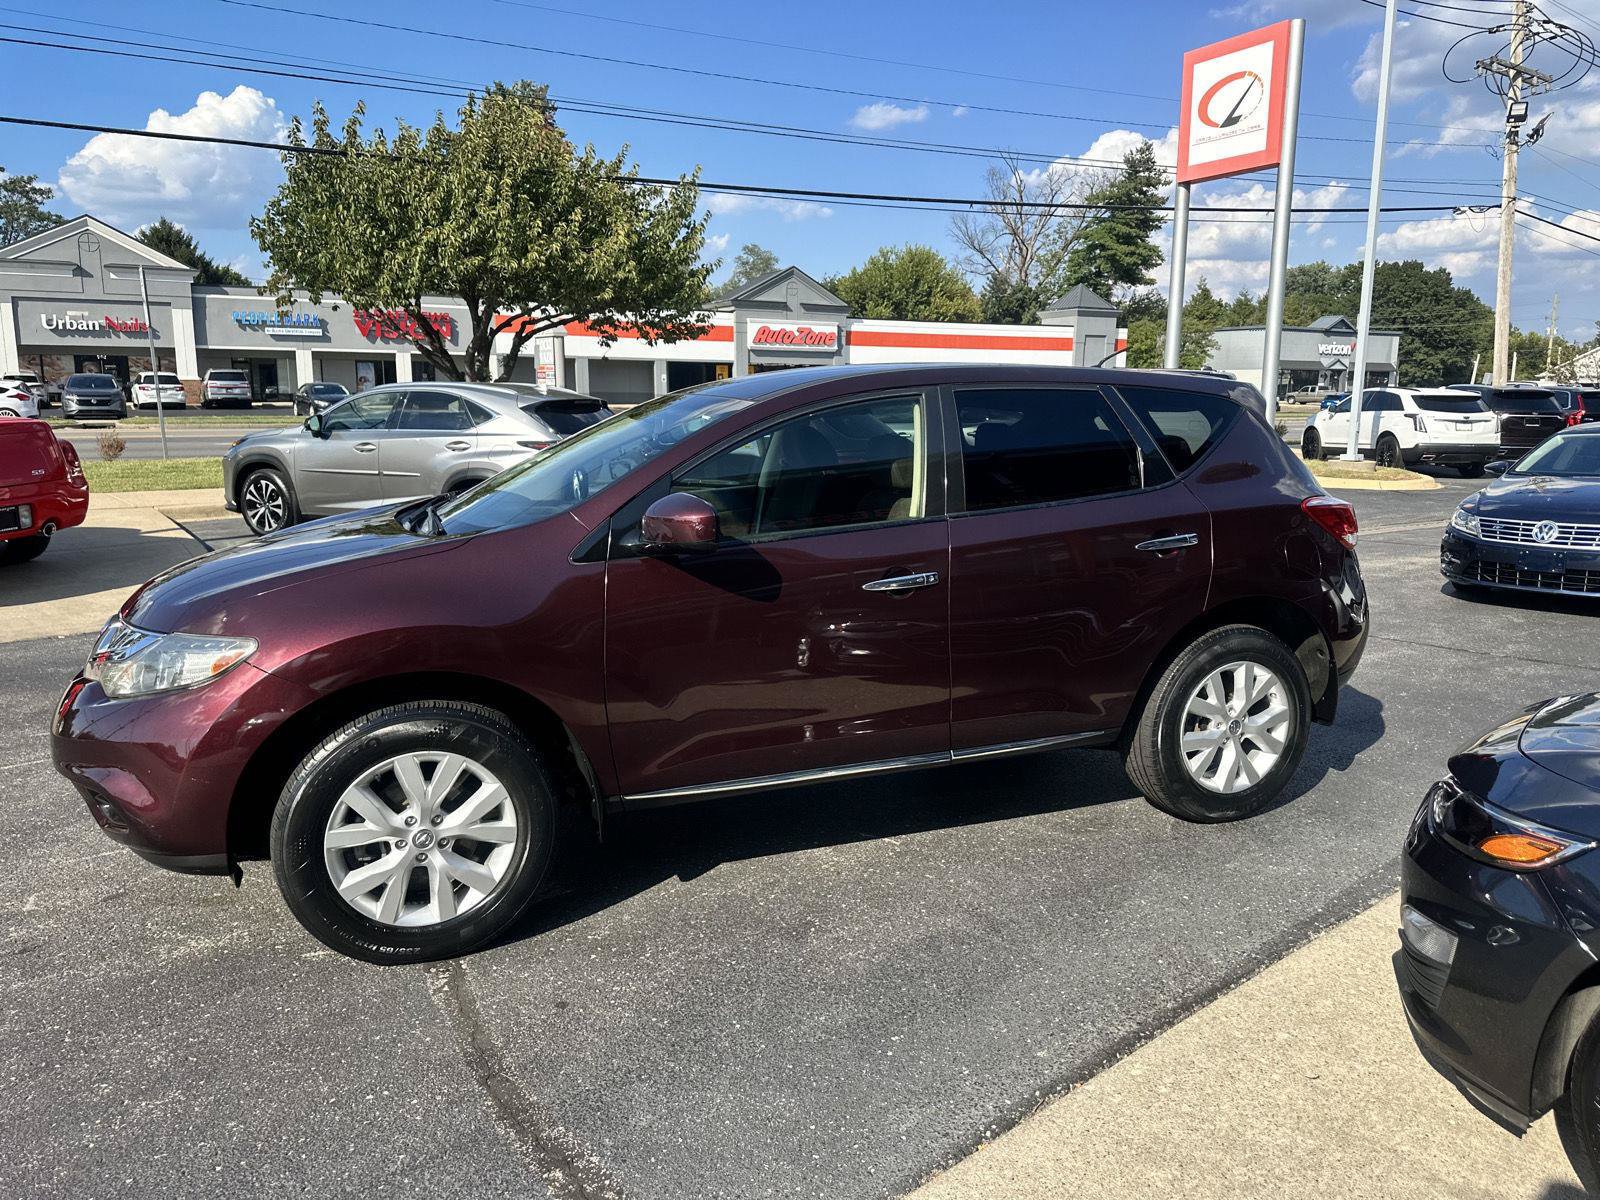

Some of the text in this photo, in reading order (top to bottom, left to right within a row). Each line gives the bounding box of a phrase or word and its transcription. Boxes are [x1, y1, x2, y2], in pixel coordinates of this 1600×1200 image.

[40, 313, 149, 332] Urban Nails
[752, 325, 837, 347] AutoZone
[1318, 341, 1352, 355] verizon
